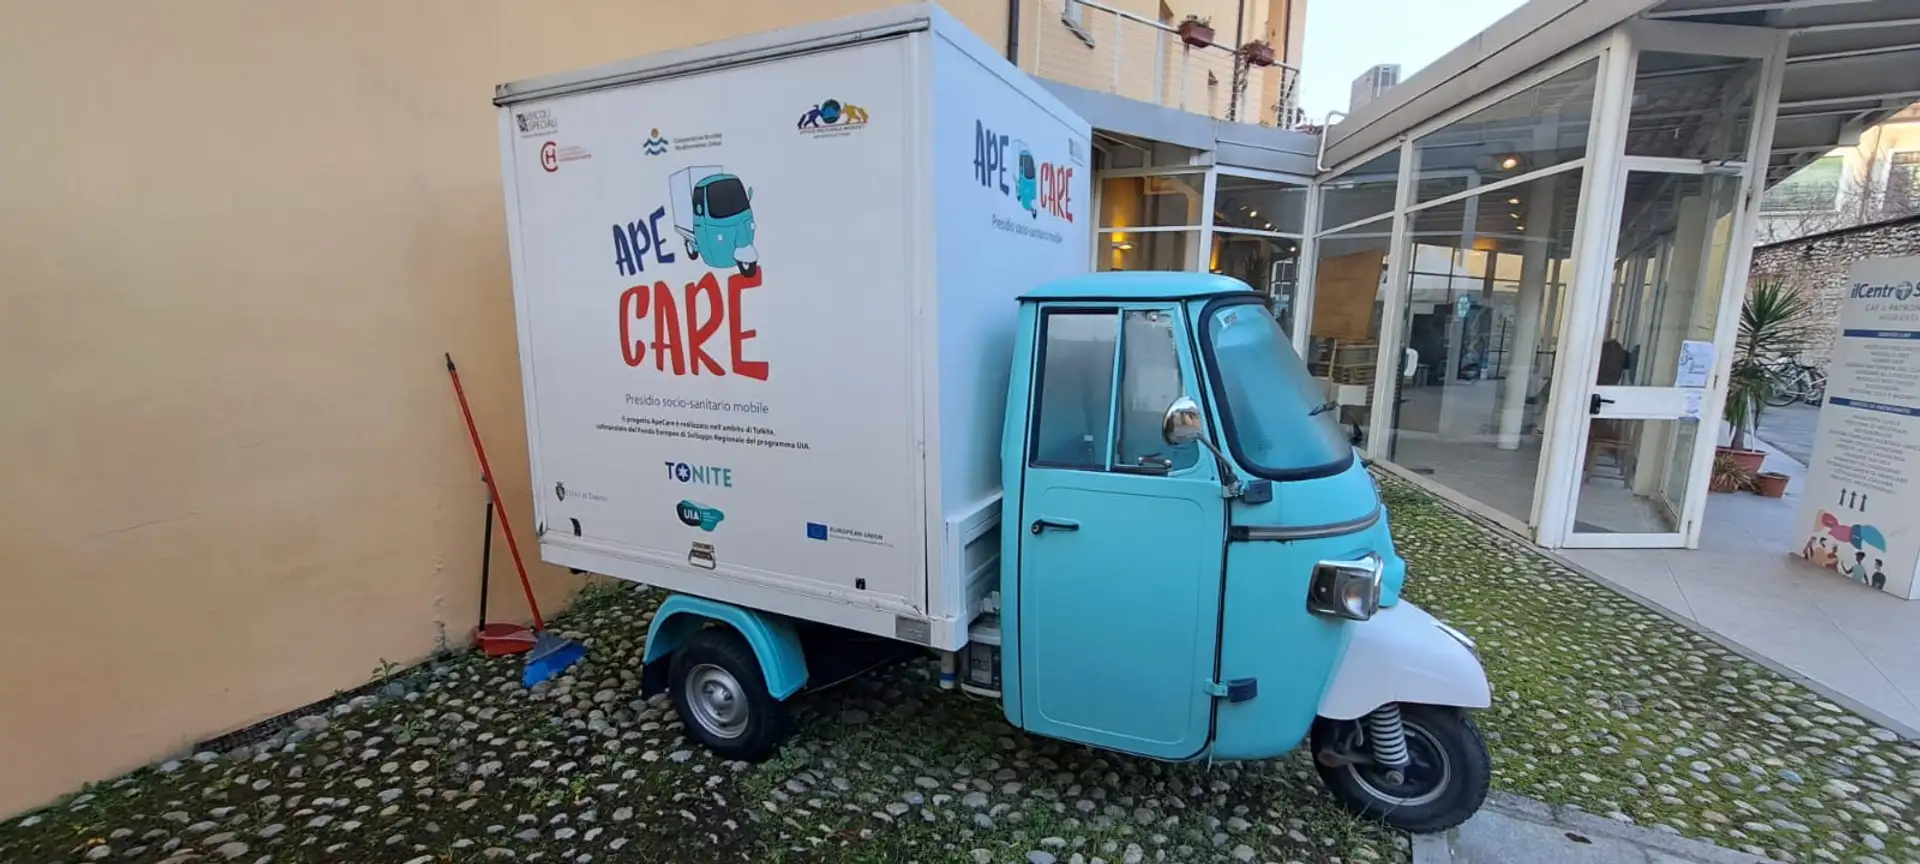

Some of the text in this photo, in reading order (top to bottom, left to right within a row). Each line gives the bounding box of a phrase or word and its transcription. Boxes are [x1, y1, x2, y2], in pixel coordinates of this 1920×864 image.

[974, 118, 1010, 197] APE
[1040, 161, 1073, 224] CARE
[613, 205, 676, 277] APE
[619, 265, 770, 382] CARE
[625, 392, 769, 415] Presidio socio-sanitario mobile
[714, 433, 745, 444] Regionale
[757, 438, 796, 449] programma
[665, 461, 732, 488] TONITE
[684, 508, 700, 520] UIA
[829, 525, 863, 538] EUROPEAN
[864, 530, 884, 541] UNION
